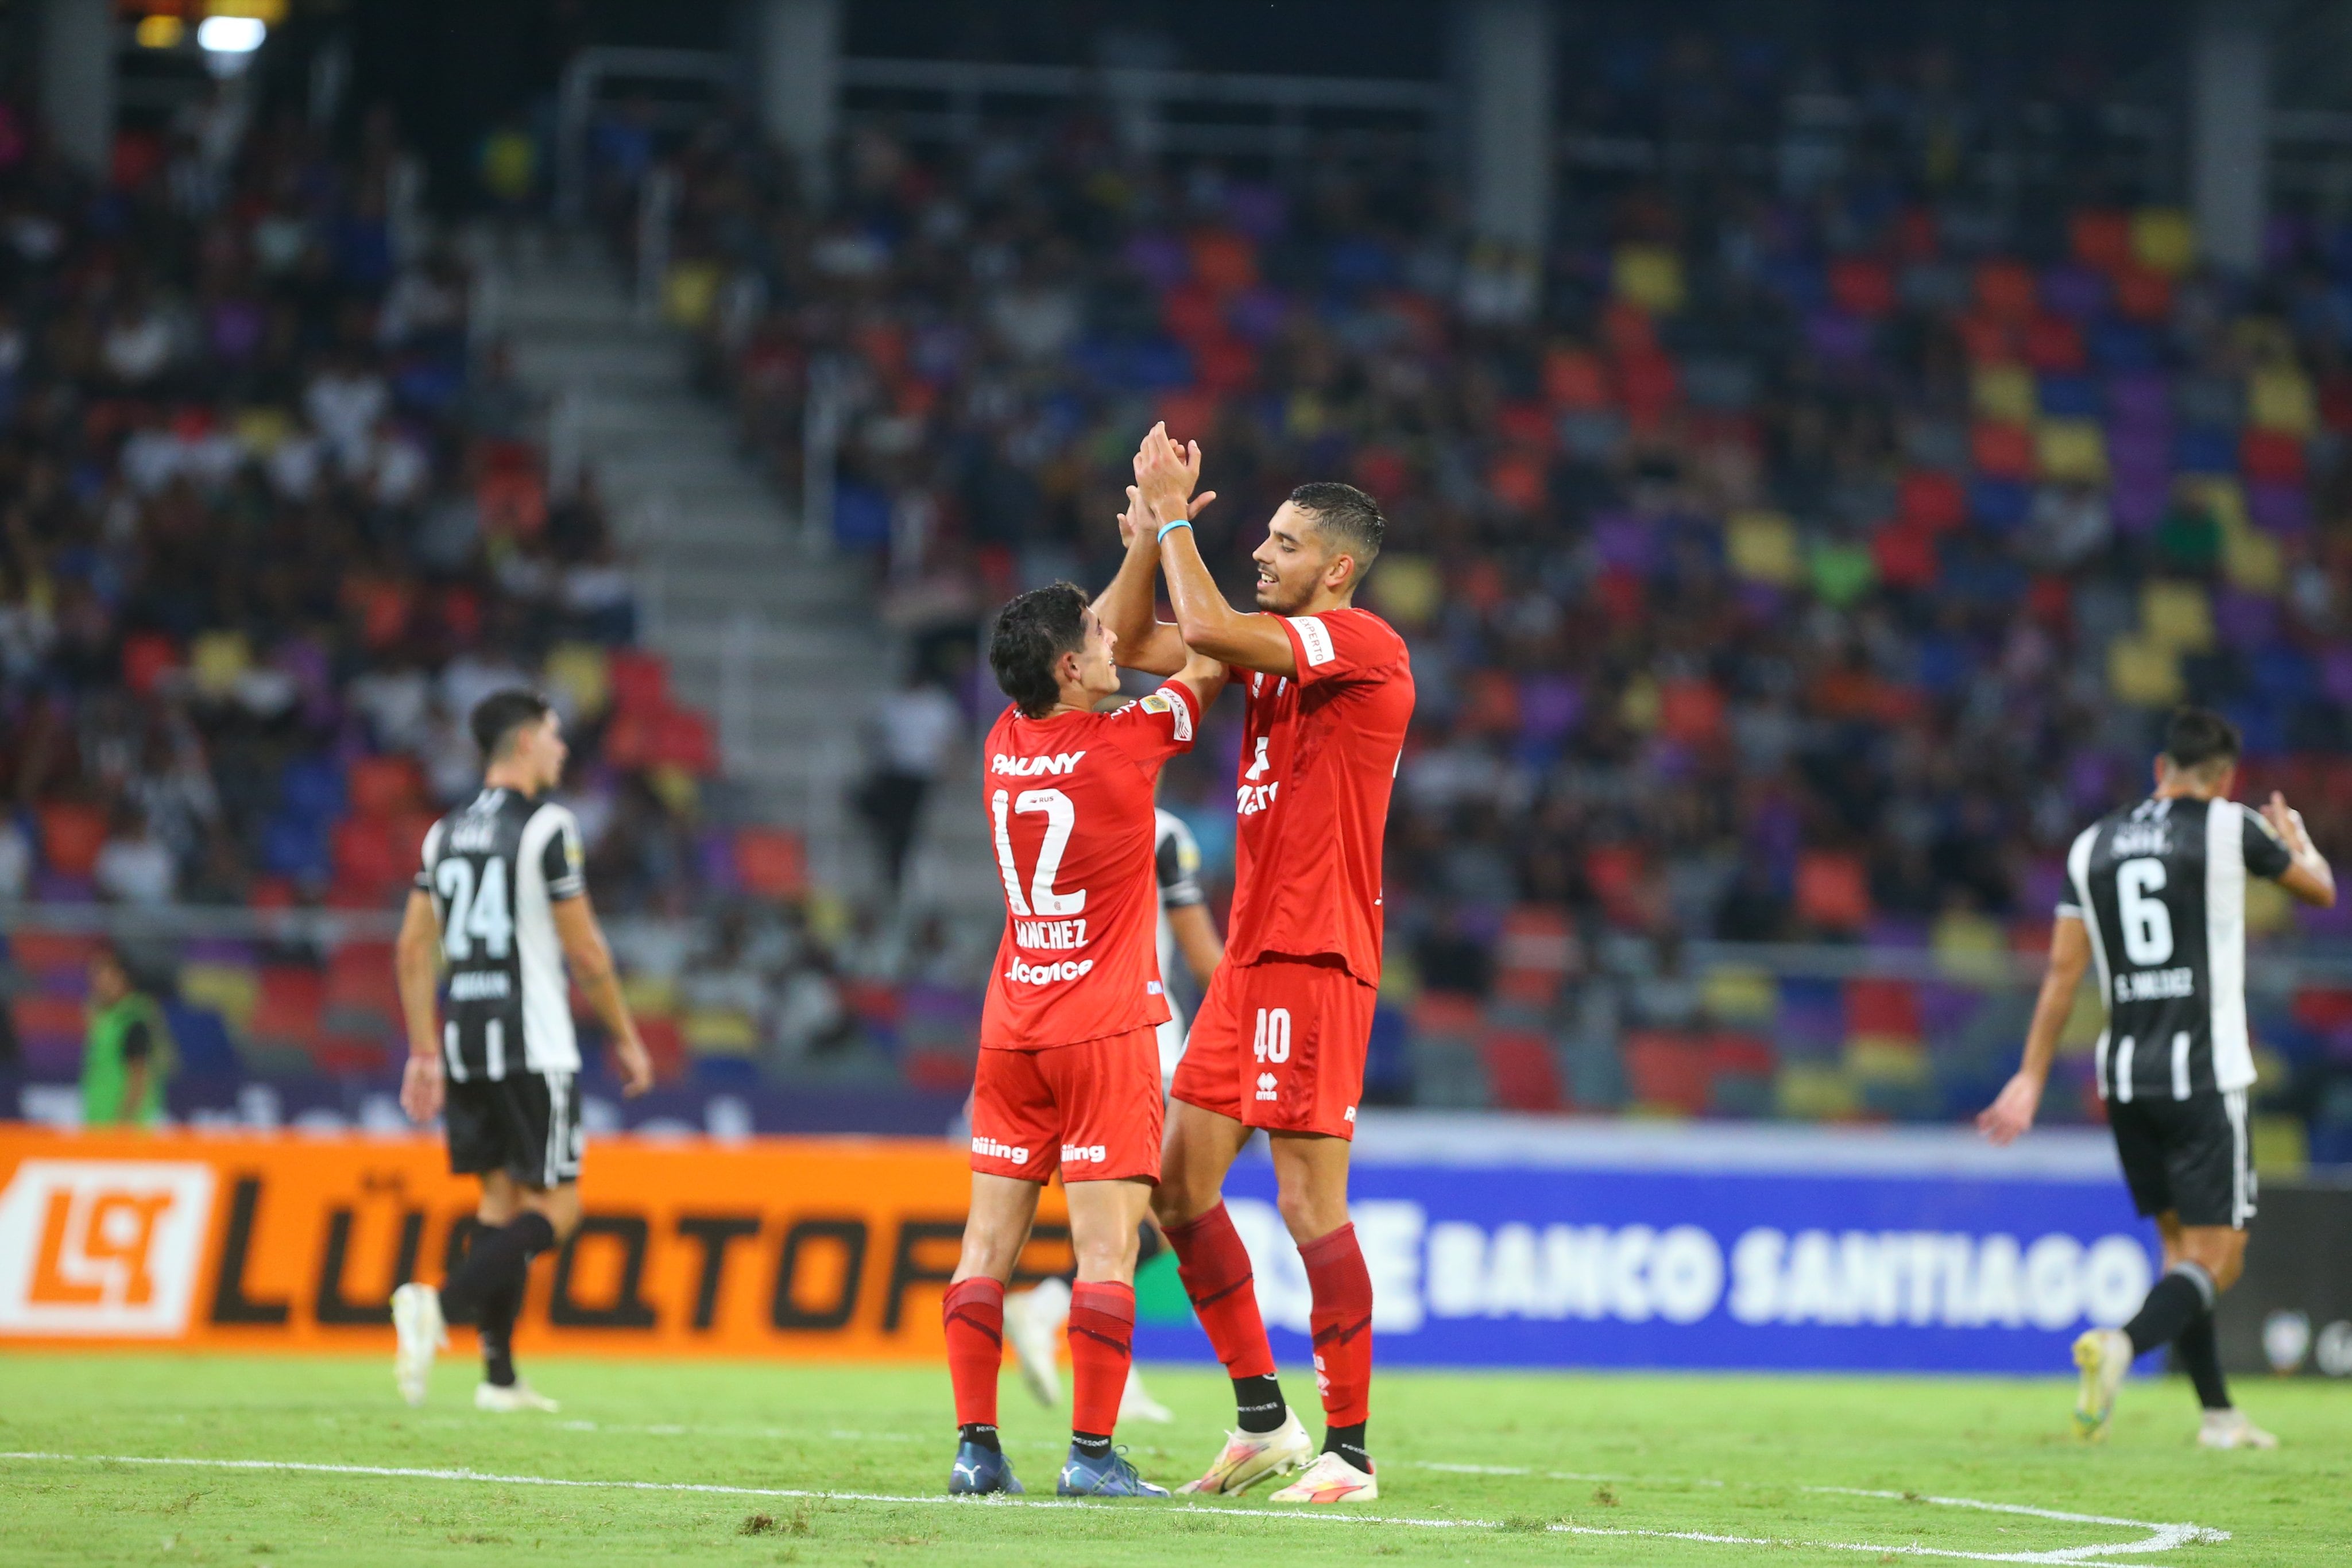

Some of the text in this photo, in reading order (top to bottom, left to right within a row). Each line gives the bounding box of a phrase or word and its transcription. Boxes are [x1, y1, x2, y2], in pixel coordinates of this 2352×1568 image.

[1299, 618, 1324, 661] EXPERTO
[991, 750, 1086, 776] PAUNY
[992, 788, 1086, 916] 12
[435, 855, 513, 959] 24
[2115, 857, 2174, 967] 6
[1004, 956, 1094, 986] lcance
[1254, 1008, 1291, 1063] 40
[972, 1136, 1029, 1165] Riiing
[1061, 1143, 1107, 1163] iiing
[1426, 1219, 1725, 1325] BANCO
[1728, 1223, 2154, 1331] SANTIAGO
